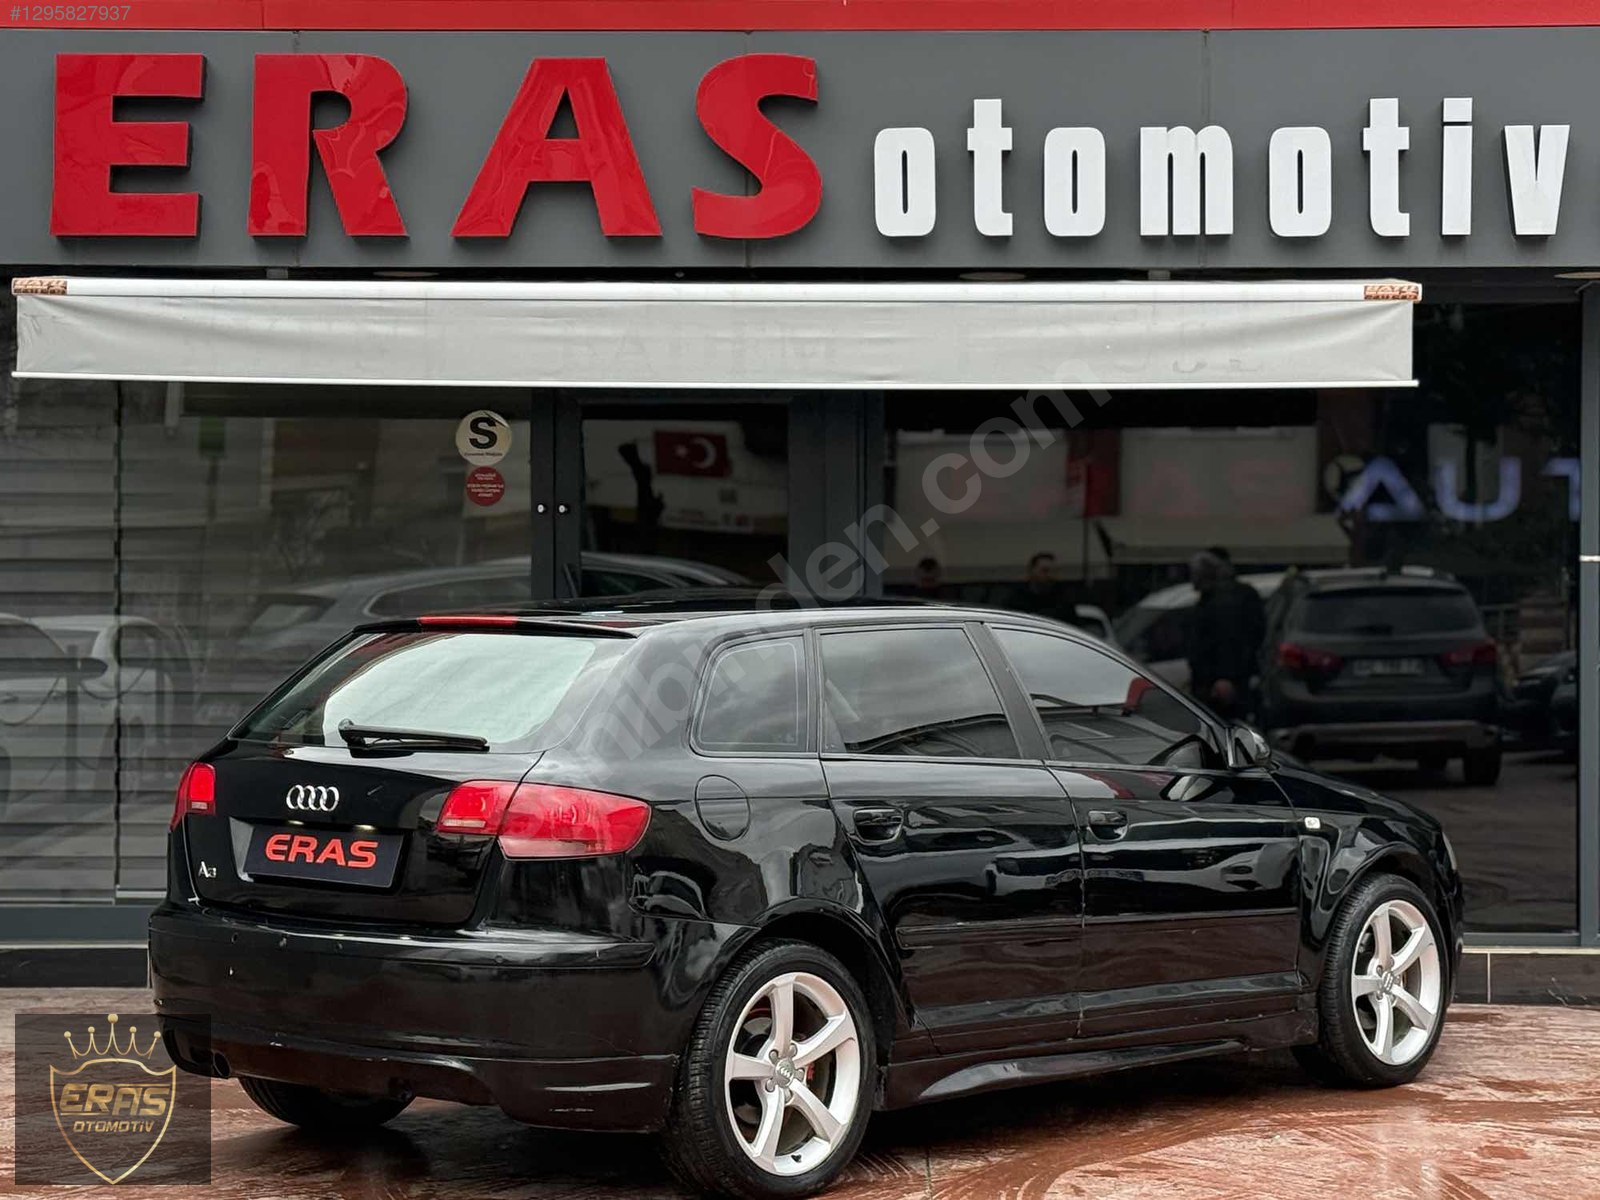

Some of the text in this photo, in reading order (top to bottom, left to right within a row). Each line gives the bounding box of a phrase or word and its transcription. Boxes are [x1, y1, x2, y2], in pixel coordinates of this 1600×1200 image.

[50, 53, 1570, 239] ERAS otomotiv
[469, 416, 498, 450] S
[265, 834, 379, 869] ERAS
[198, 861, 216, 879] A3
